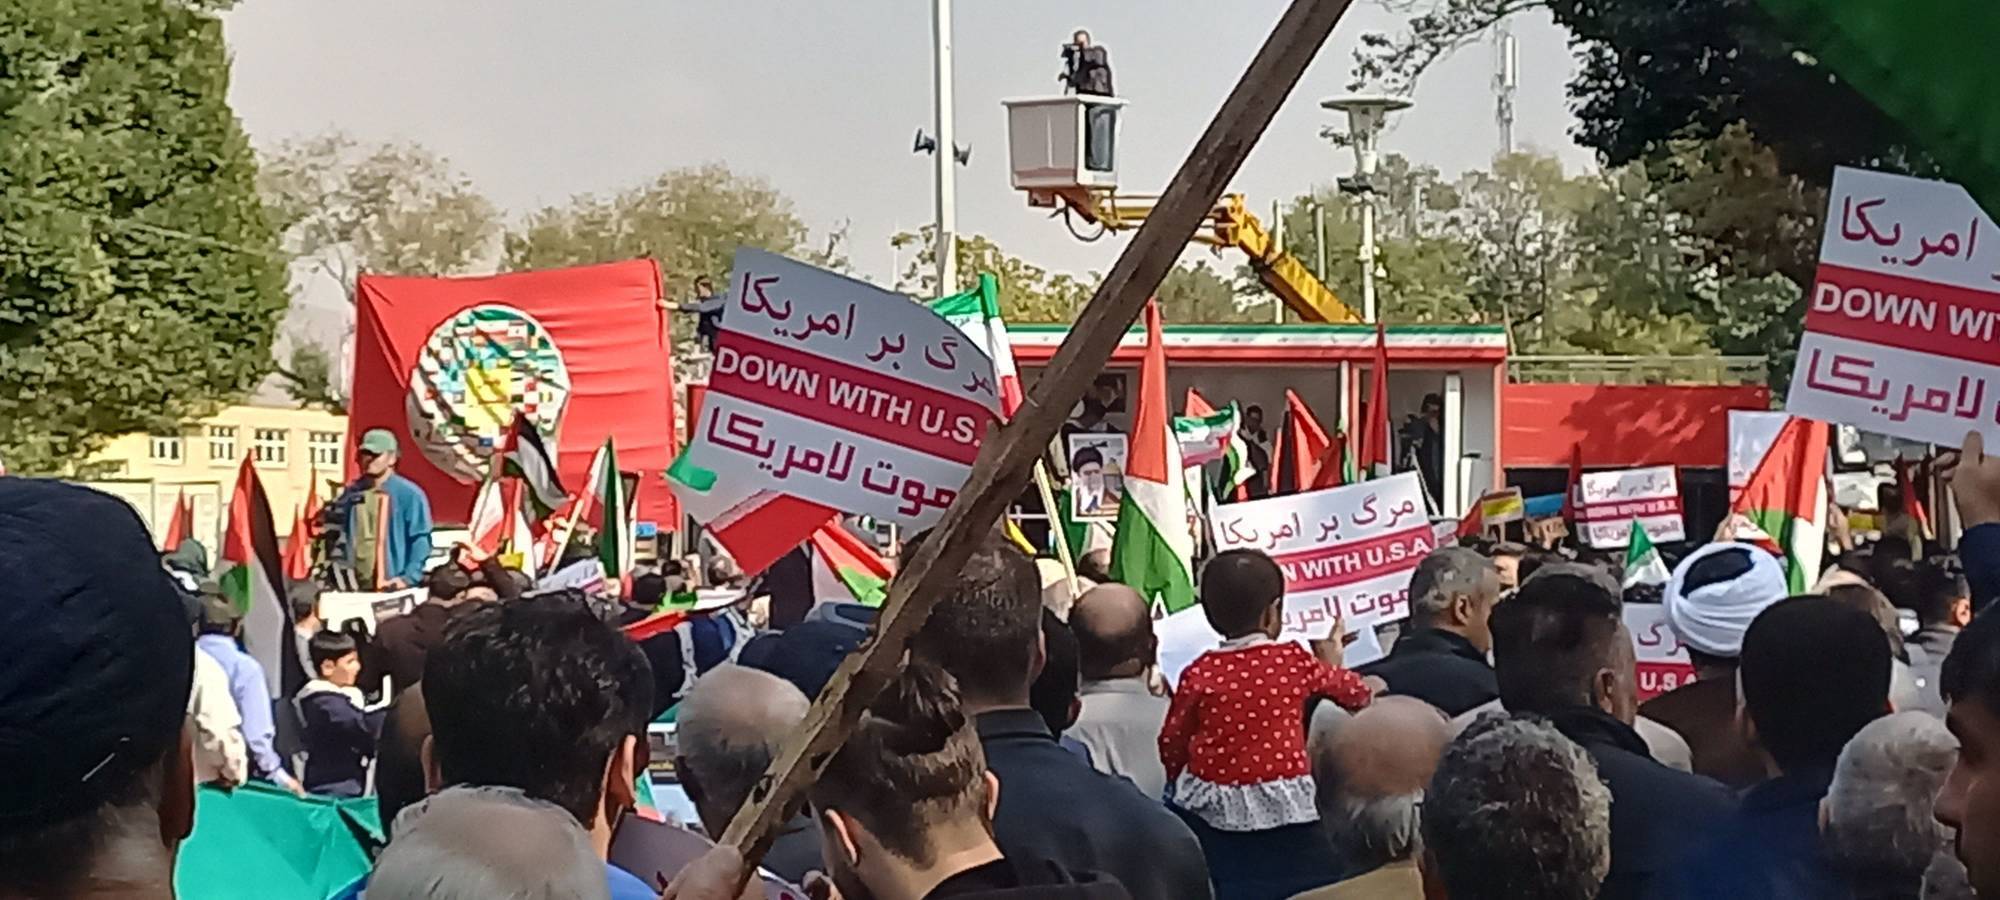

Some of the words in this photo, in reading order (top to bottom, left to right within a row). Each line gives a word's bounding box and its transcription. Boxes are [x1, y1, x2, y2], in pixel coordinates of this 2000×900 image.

[1841, 196, 1979, 267] امریکا
[740, 272, 856, 341] امریکا
[1813, 282, 1938, 331] DOWN
[1948, 304, 2000, 342] WI
[865, 334, 905, 371] بر
[716, 347, 819, 400] DOWN
[829, 377, 913, 426] WITH
[920, 405, 982, 448] U.S.
[1315, 510, 1340, 542] بر
[1352, 493, 1415, 528] مرگ
[1301, 555, 1362, 580] WITH
